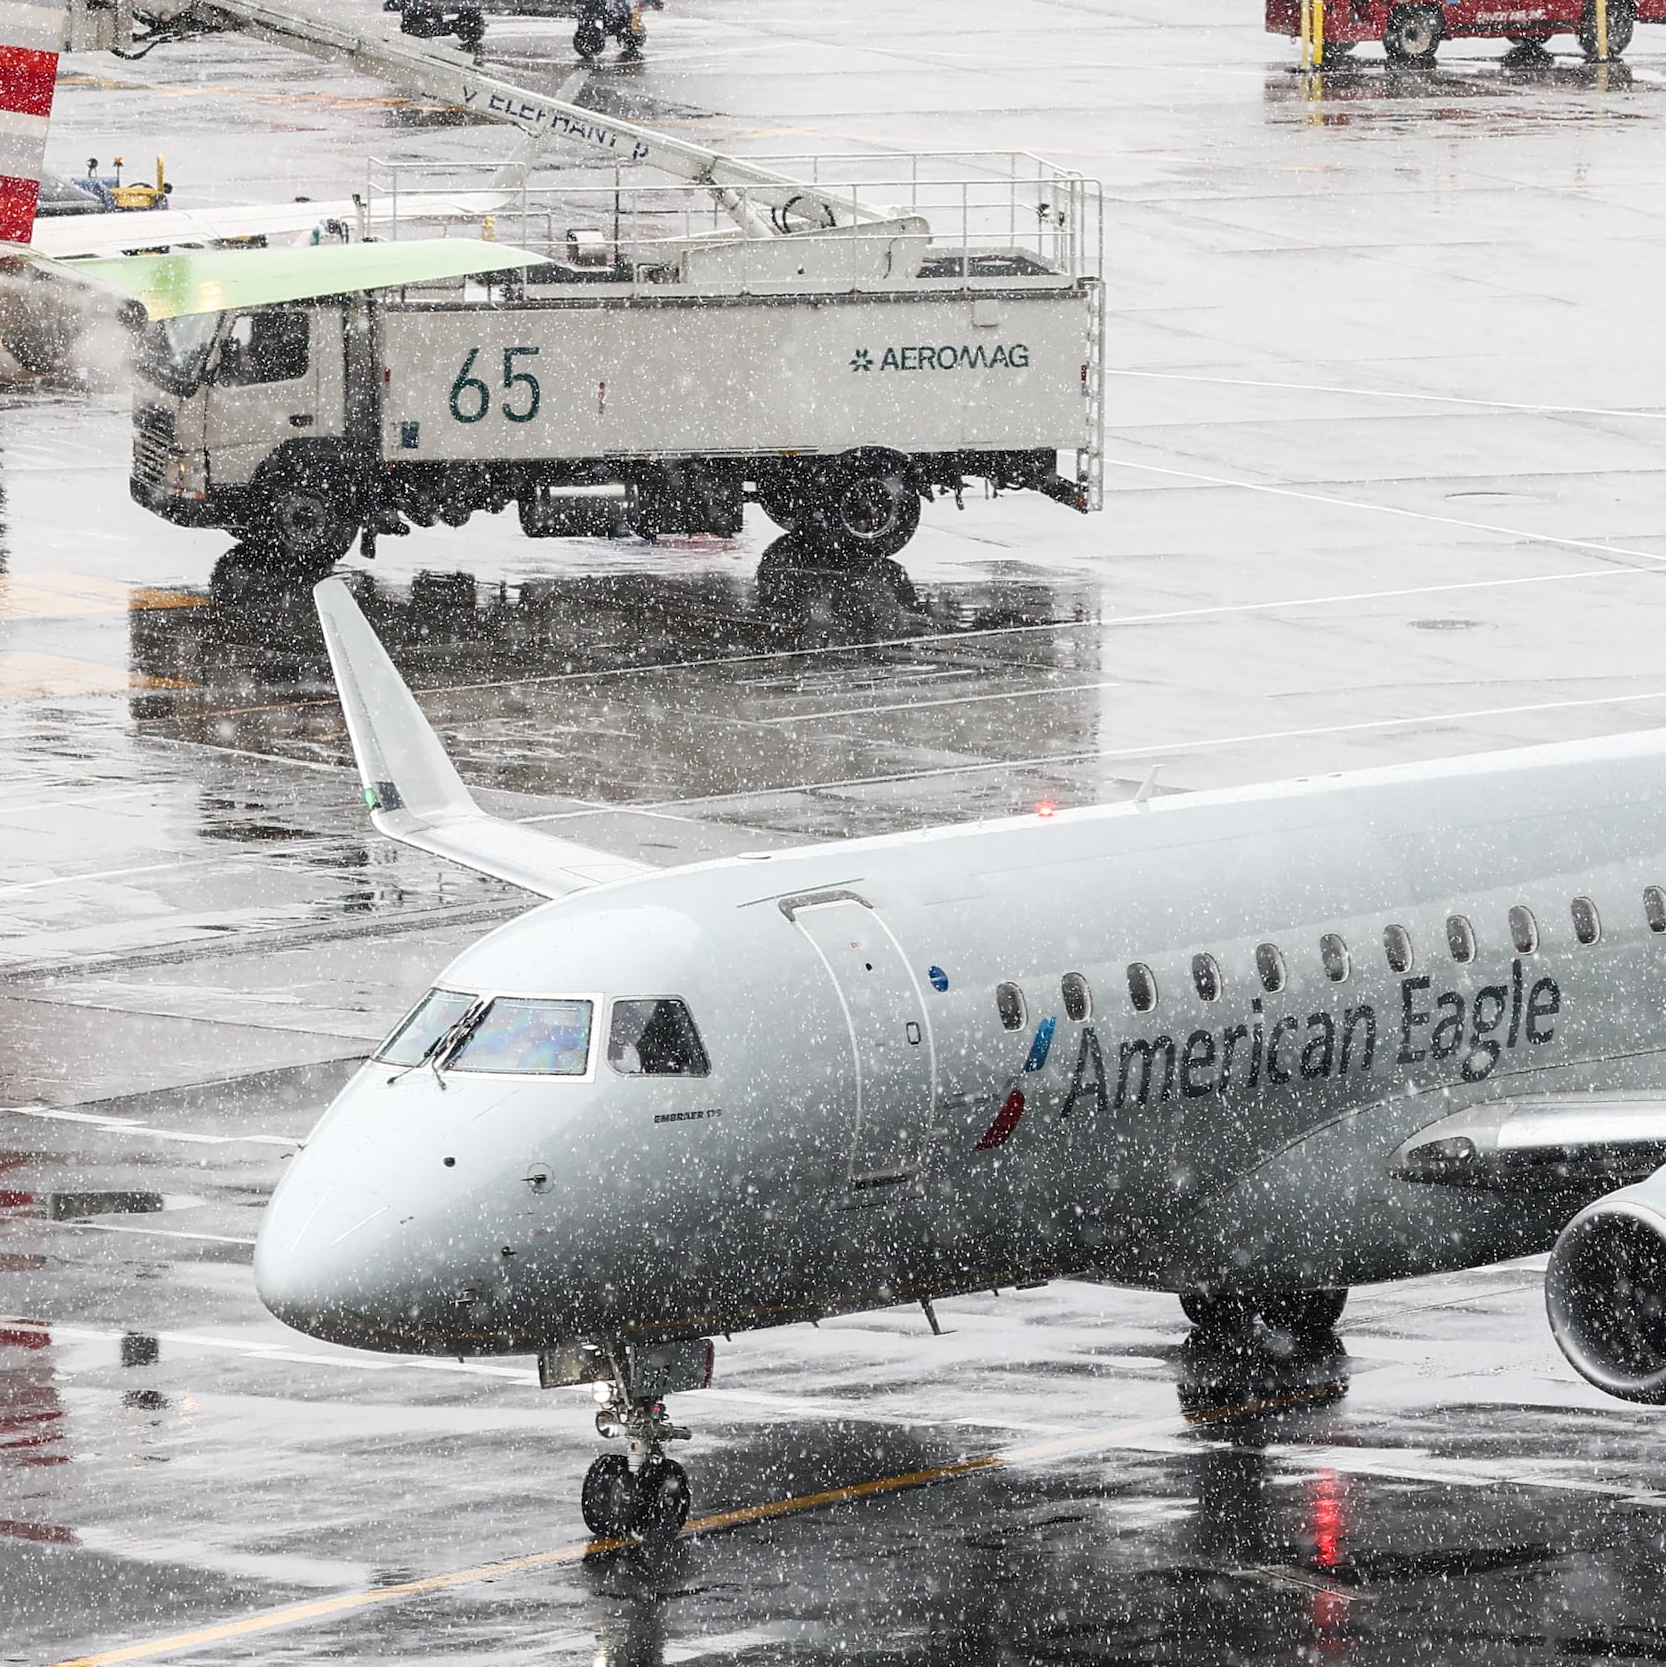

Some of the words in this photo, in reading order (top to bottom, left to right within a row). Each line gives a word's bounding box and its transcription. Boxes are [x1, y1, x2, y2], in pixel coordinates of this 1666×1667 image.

[879, 343, 1030, 372] AEROMAG
[448, 346, 541, 424] 65
[1060, 997, 1378, 1120] American
[1395, 958, 1562, 1083] Eagle
[654, 1110, 704, 1123] EMBRAER
